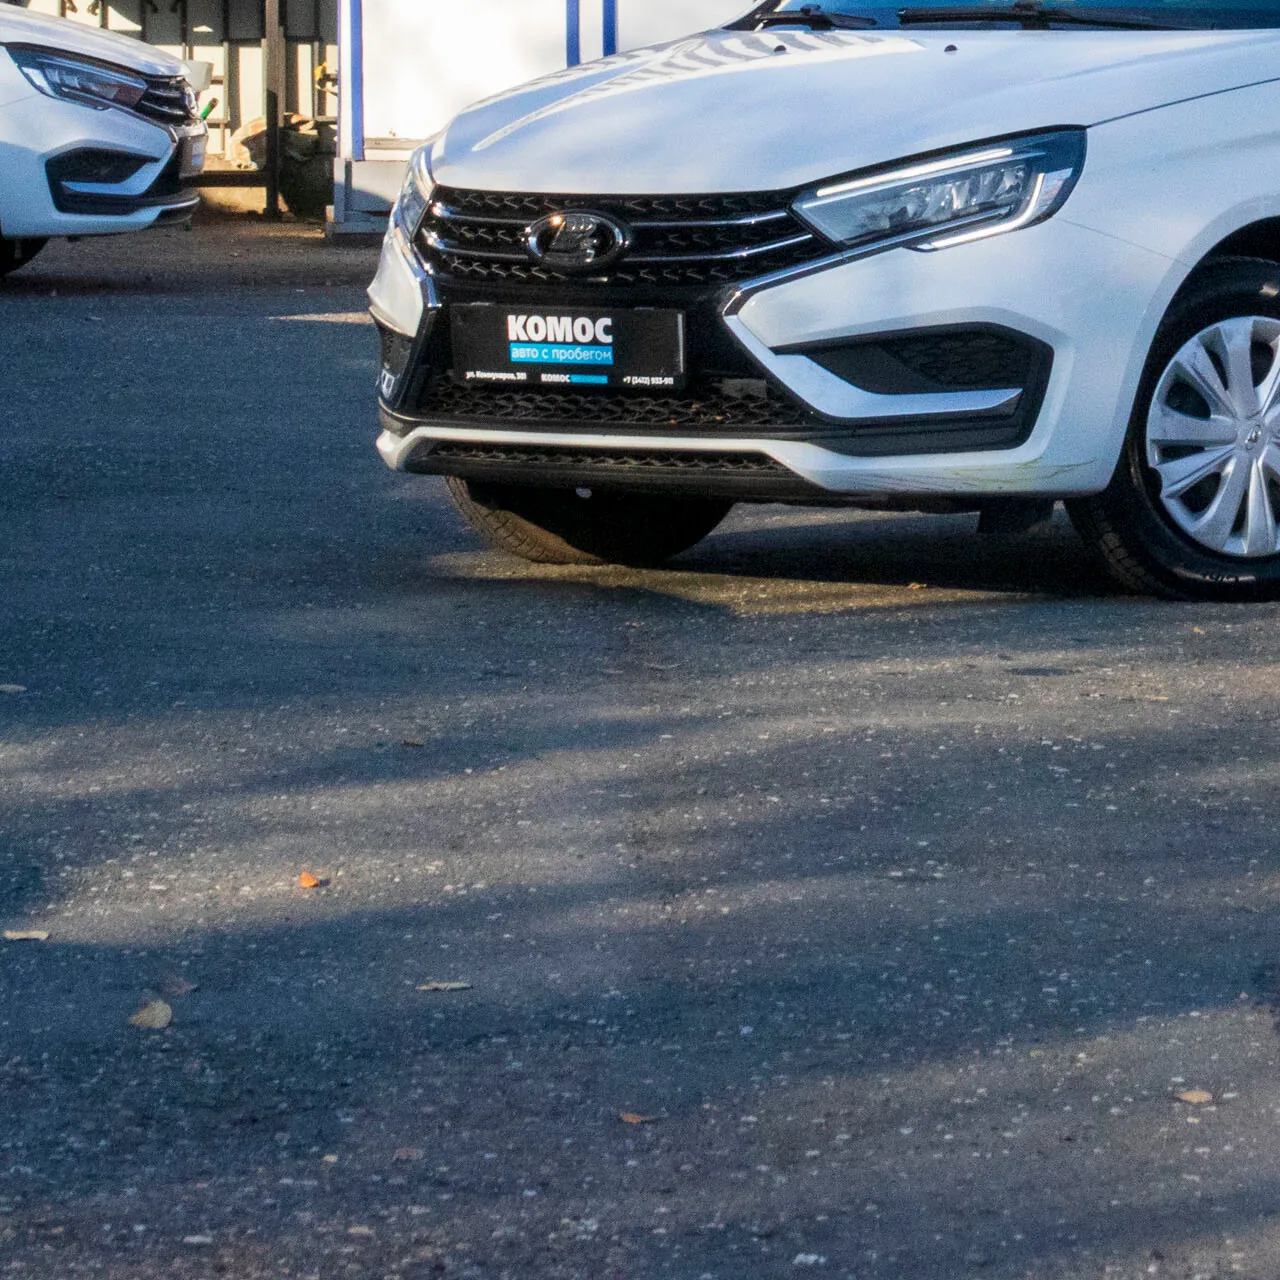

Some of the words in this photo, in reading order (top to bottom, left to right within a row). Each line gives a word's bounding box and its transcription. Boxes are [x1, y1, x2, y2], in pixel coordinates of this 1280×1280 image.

[507, 314, 613, 343] КОМОС
[511, 347, 539, 359] авто
[541, 348, 549, 359] с
[551, 347, 612, 361] пробегом
[541, 373, 571, 383] КОМОС
